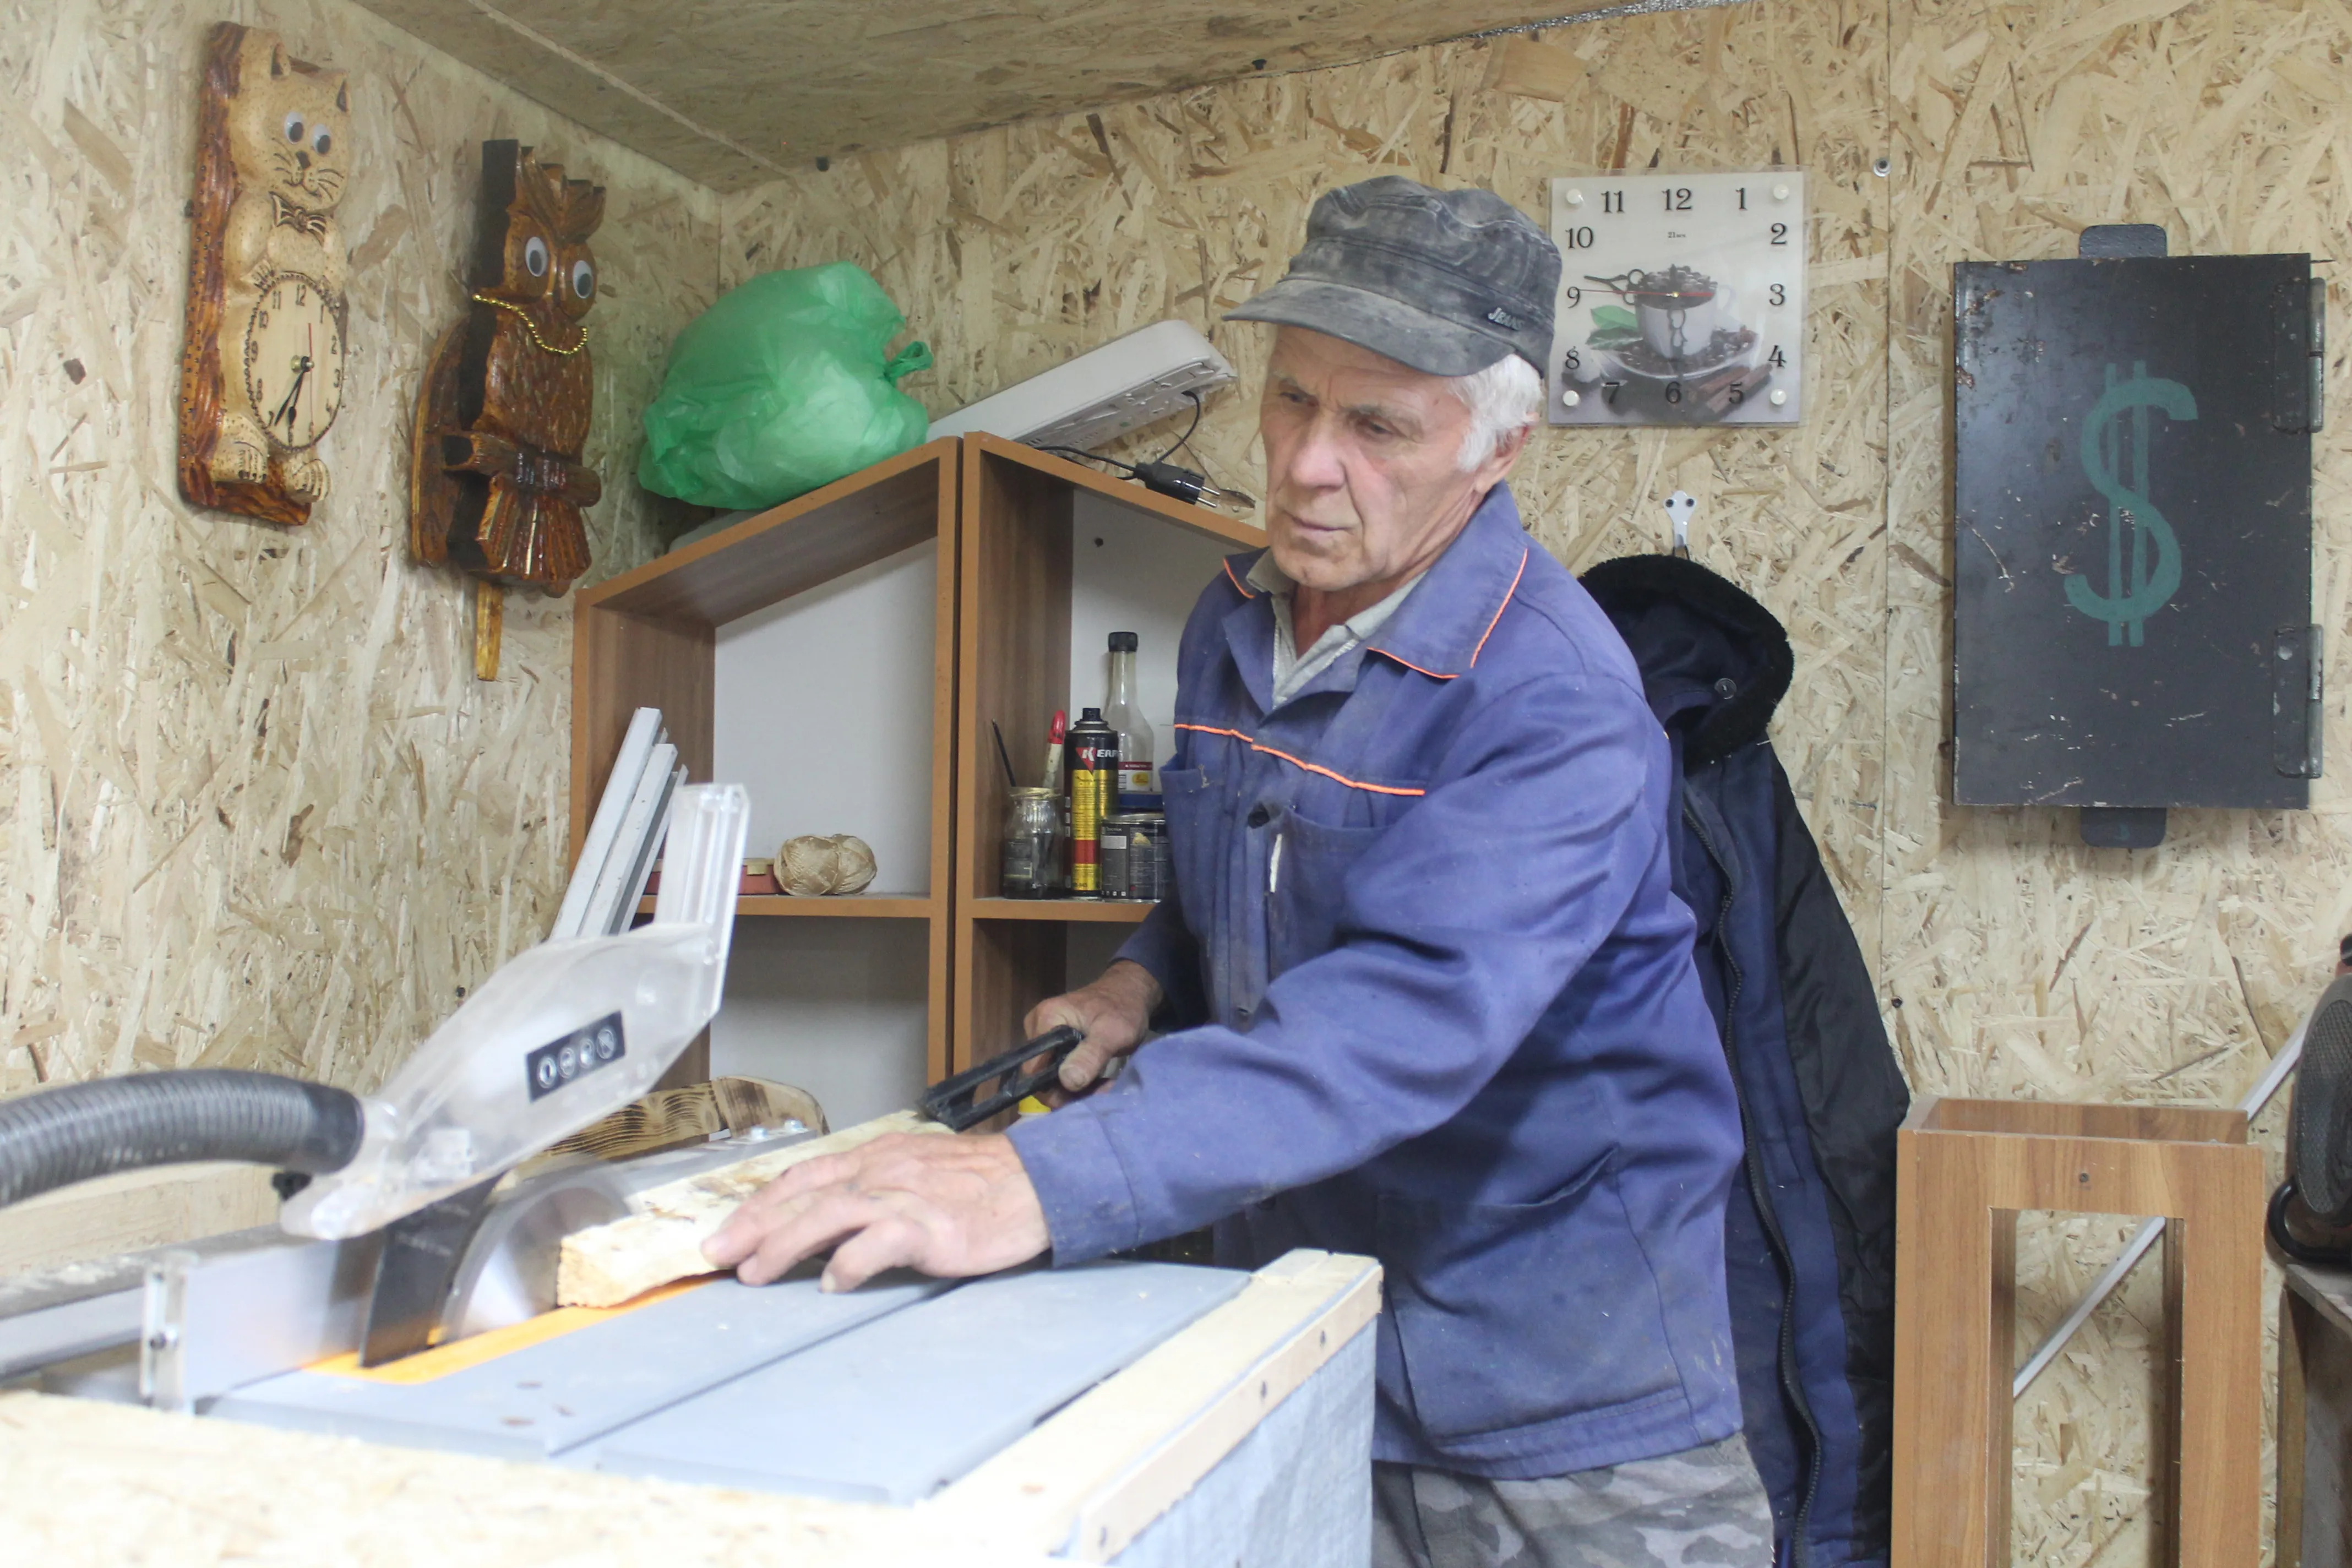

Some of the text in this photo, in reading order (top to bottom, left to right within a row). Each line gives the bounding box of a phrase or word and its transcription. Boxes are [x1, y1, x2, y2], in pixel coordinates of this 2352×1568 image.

[1601, 190, 1625, 214] 11
[1662, 188, 1692, 210] 12
[1735, 187, 1747, 210] 1
[1565, 226, 1594, 249] 10
[1770, 223, 1788, 245] 2
[273, 290, 281, 309] 11
[296, 284, 306, 306] 12
[1567, 286, 1580, 308] 9
[1769, 284, 1785, 306] 3
[320, 304, 324, 324] 1
[1488, 307, 1525, 331] JEANS
[251, 341, 258, 362] 9
[331, 335, 337, 355] 2
[1565, 346, 1580, 369] 8
[1768, 345, 1786, 368] 4
[334, 368, 340, 388] 3
[256, 378, 263, 402] 8
[1605, 382, 1620, 404] 7
[1665, 382, 1681, 404] 6
[1728, 383, 1744, 404] 5
[266, 411, 274, 428] 7
[2063, 360, 2198, 646] $
